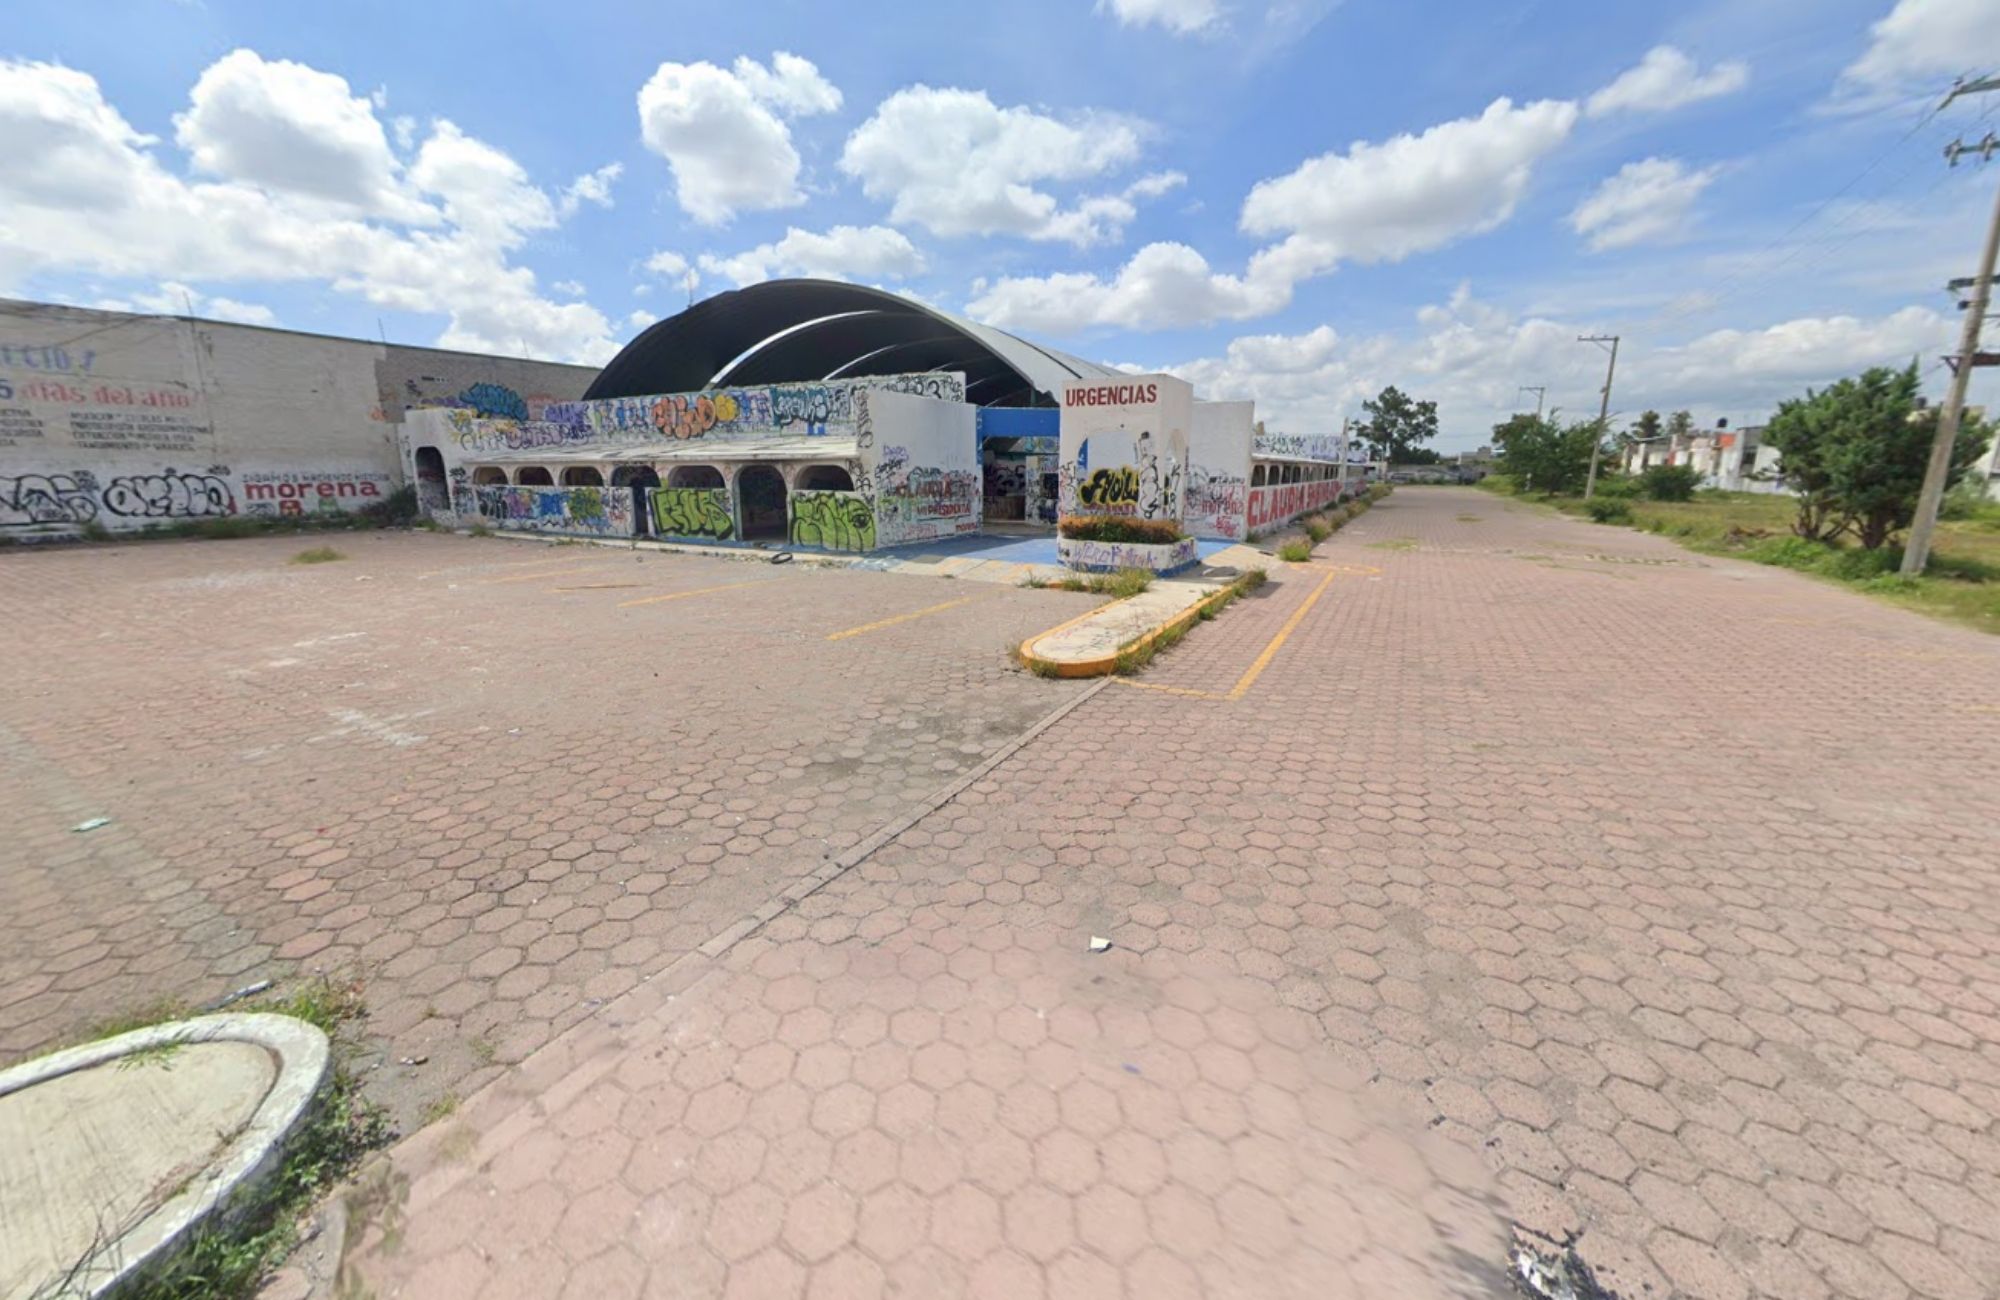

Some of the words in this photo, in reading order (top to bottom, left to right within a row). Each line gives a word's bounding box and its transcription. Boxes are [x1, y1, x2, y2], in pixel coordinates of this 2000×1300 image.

[1066, 384, 1158, 408] URGENCIAS
[244, 480, 381, 500] morena
[1247, 480, 1305, 528] CLAUDIA
